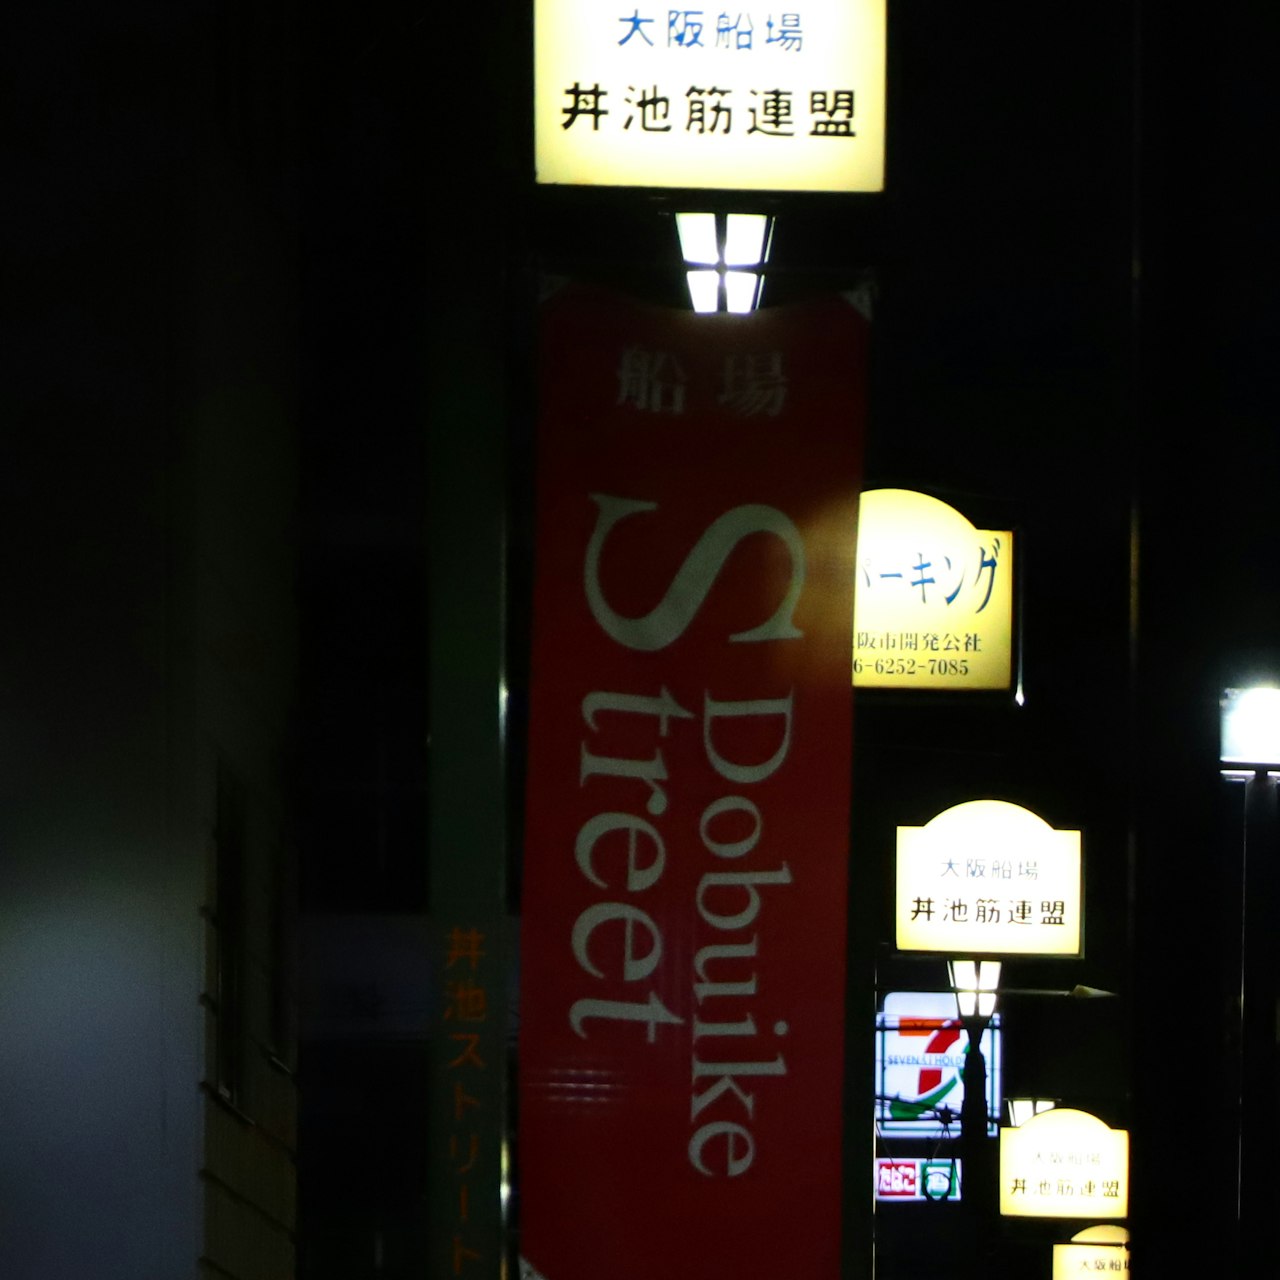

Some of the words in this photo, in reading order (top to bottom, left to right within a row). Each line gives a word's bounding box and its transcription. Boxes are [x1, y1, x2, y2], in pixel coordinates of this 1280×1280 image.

[617, 9, 804, 52] 大阪船場
[561, 81, 857, 138] 丼池筋連盟
[615, 340, 791, 419] 船場
[853, 632, 982, 652] 阪市開発公社
[566, 491, 808, 1046] Street
[940, 857, 1039, 881] 大阪船場
[686, 684, 796, 1181] Dobuike
